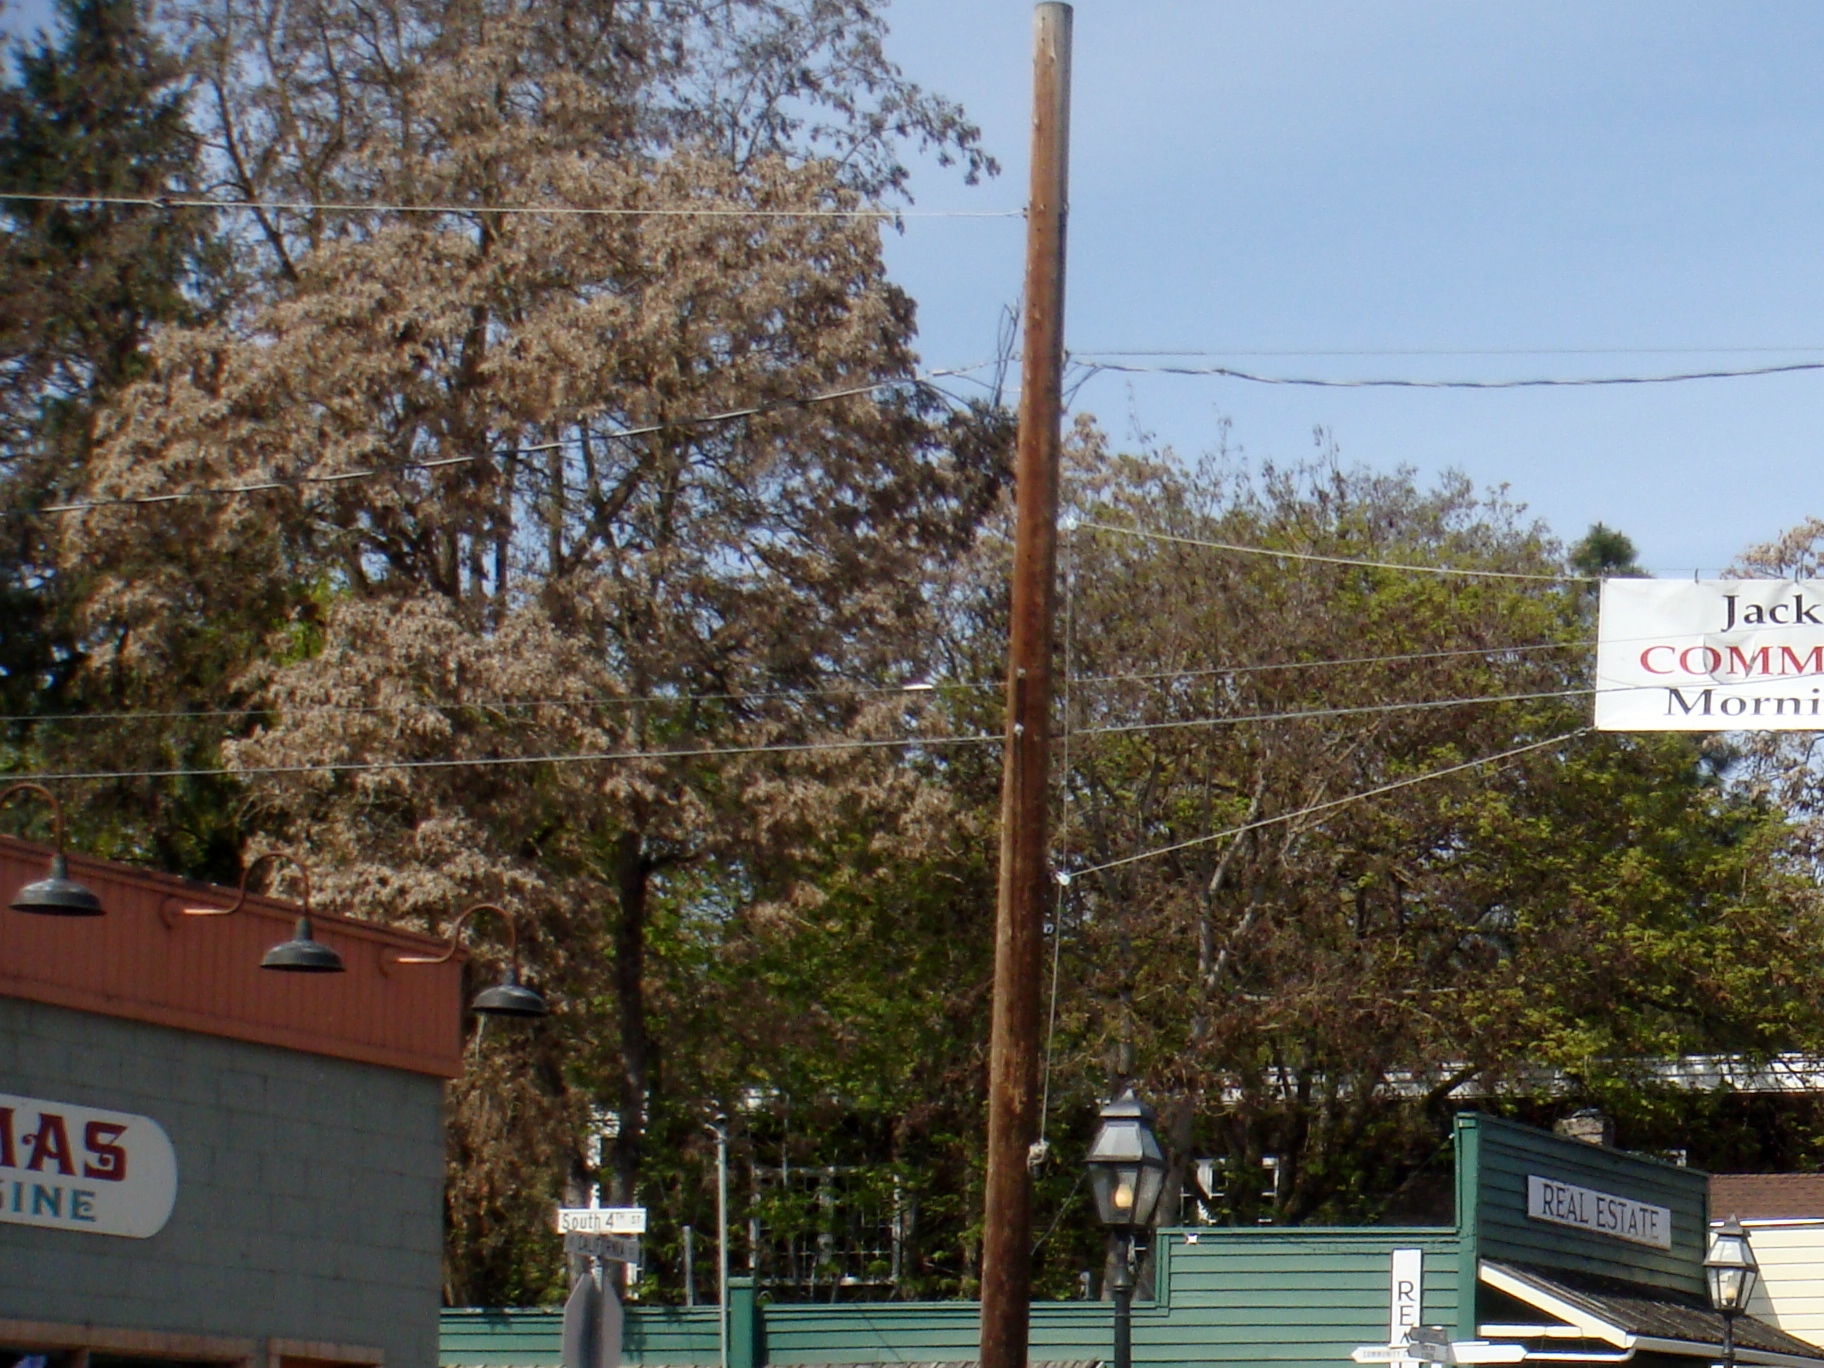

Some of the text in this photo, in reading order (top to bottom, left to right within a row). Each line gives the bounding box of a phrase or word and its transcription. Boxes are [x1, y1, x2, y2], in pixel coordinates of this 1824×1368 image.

[0, 1179, 96, 1222] INE
[562, 1213, 600, 1230] South
[1542, 1182, 1659, 1239] REAL ESTATE
